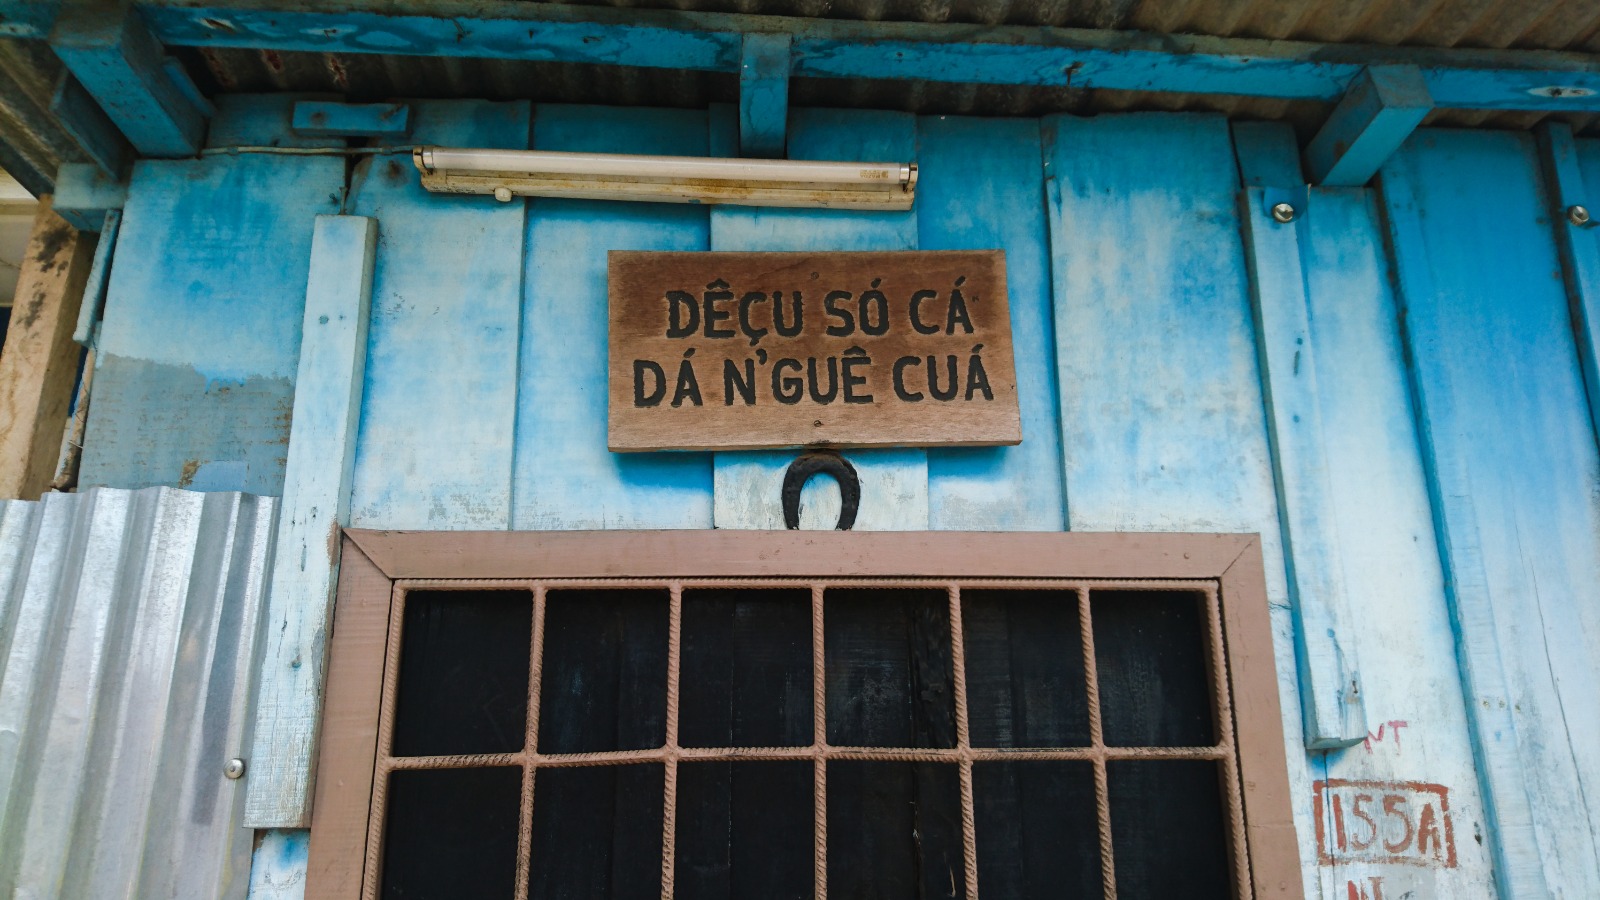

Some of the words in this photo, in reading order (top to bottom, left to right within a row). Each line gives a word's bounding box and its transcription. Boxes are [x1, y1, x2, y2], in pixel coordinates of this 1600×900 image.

[664, 278, 804, 346] DÊÇU
[823, 278, 890, 337] SÓ
[908, 275, 975, 336] CÁ
[632, 348, 704, 408] DÁ
[892, 344, 994, 402] CUÁ
[1332, 794, 1441, 858] 155A
